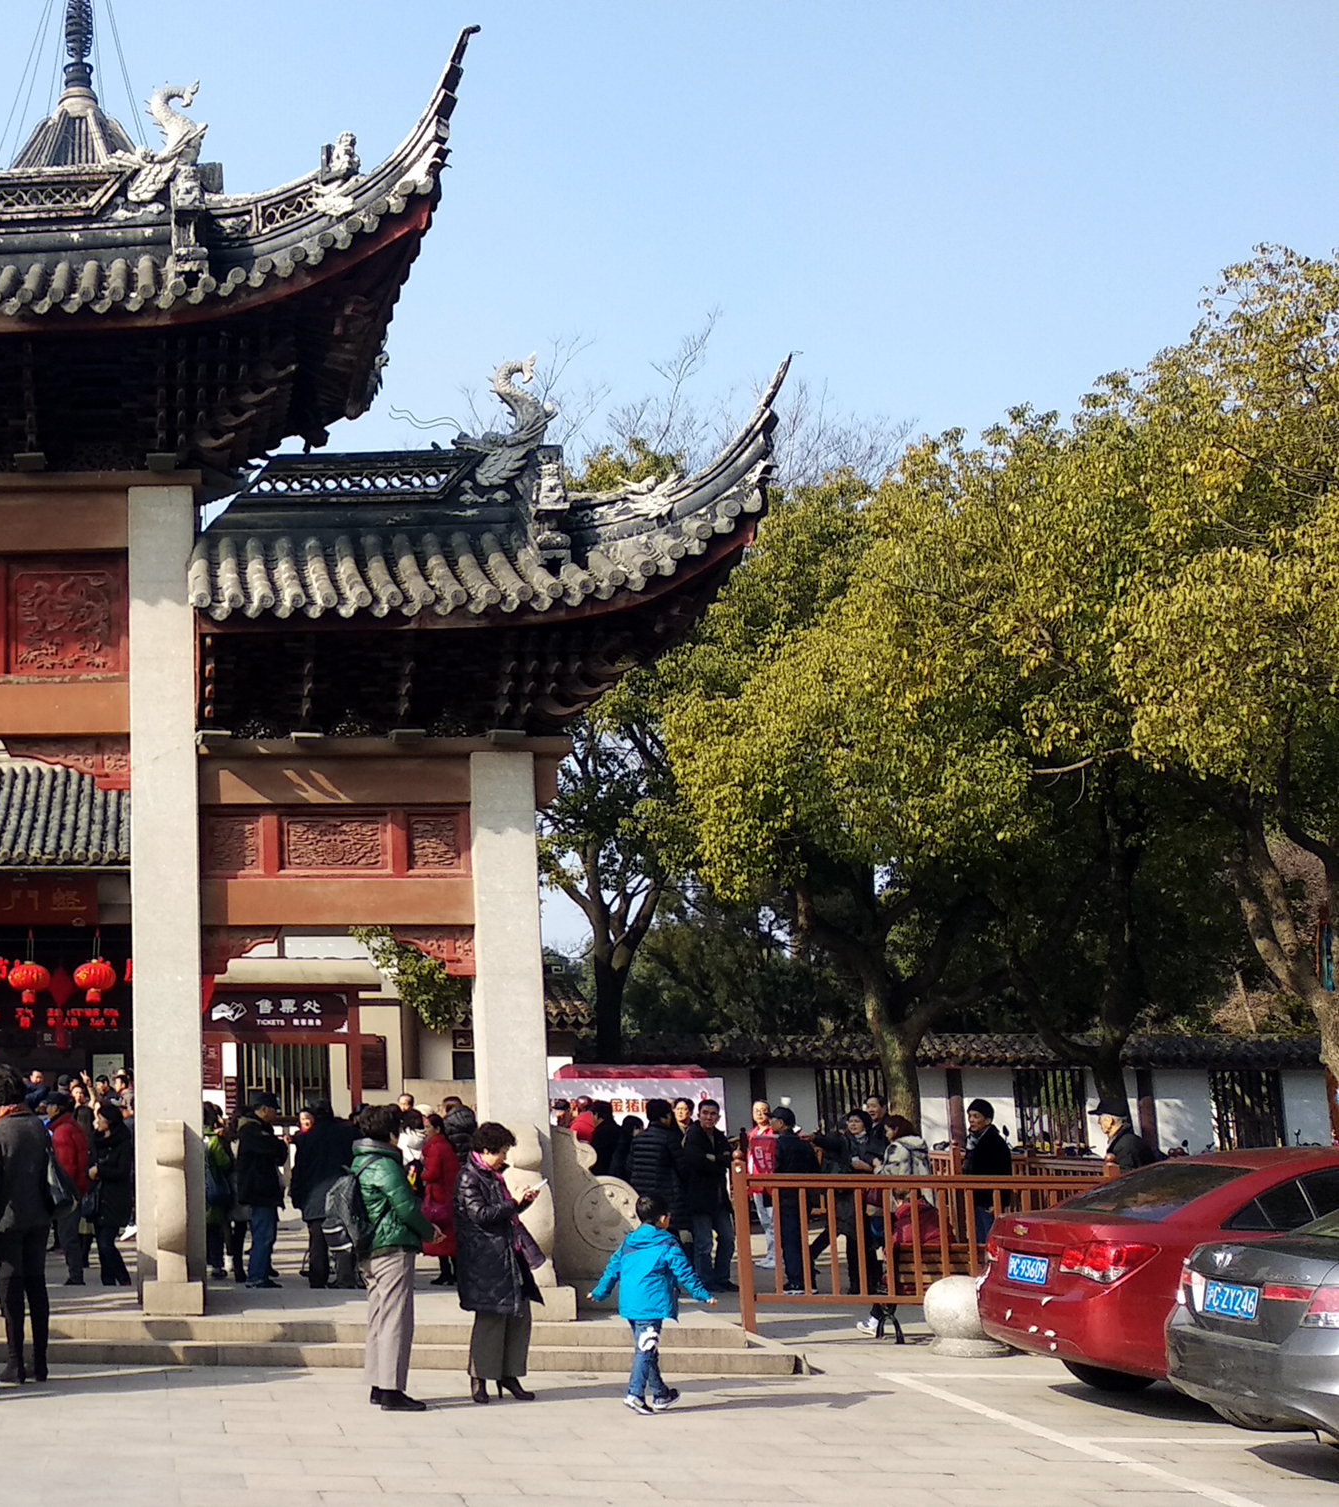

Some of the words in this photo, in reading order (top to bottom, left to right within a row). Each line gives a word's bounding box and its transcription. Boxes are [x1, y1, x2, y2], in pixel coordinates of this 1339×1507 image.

[255, 998, 322, 1015] 售票处
[256, 1018, 285, 1026] TICKETS
